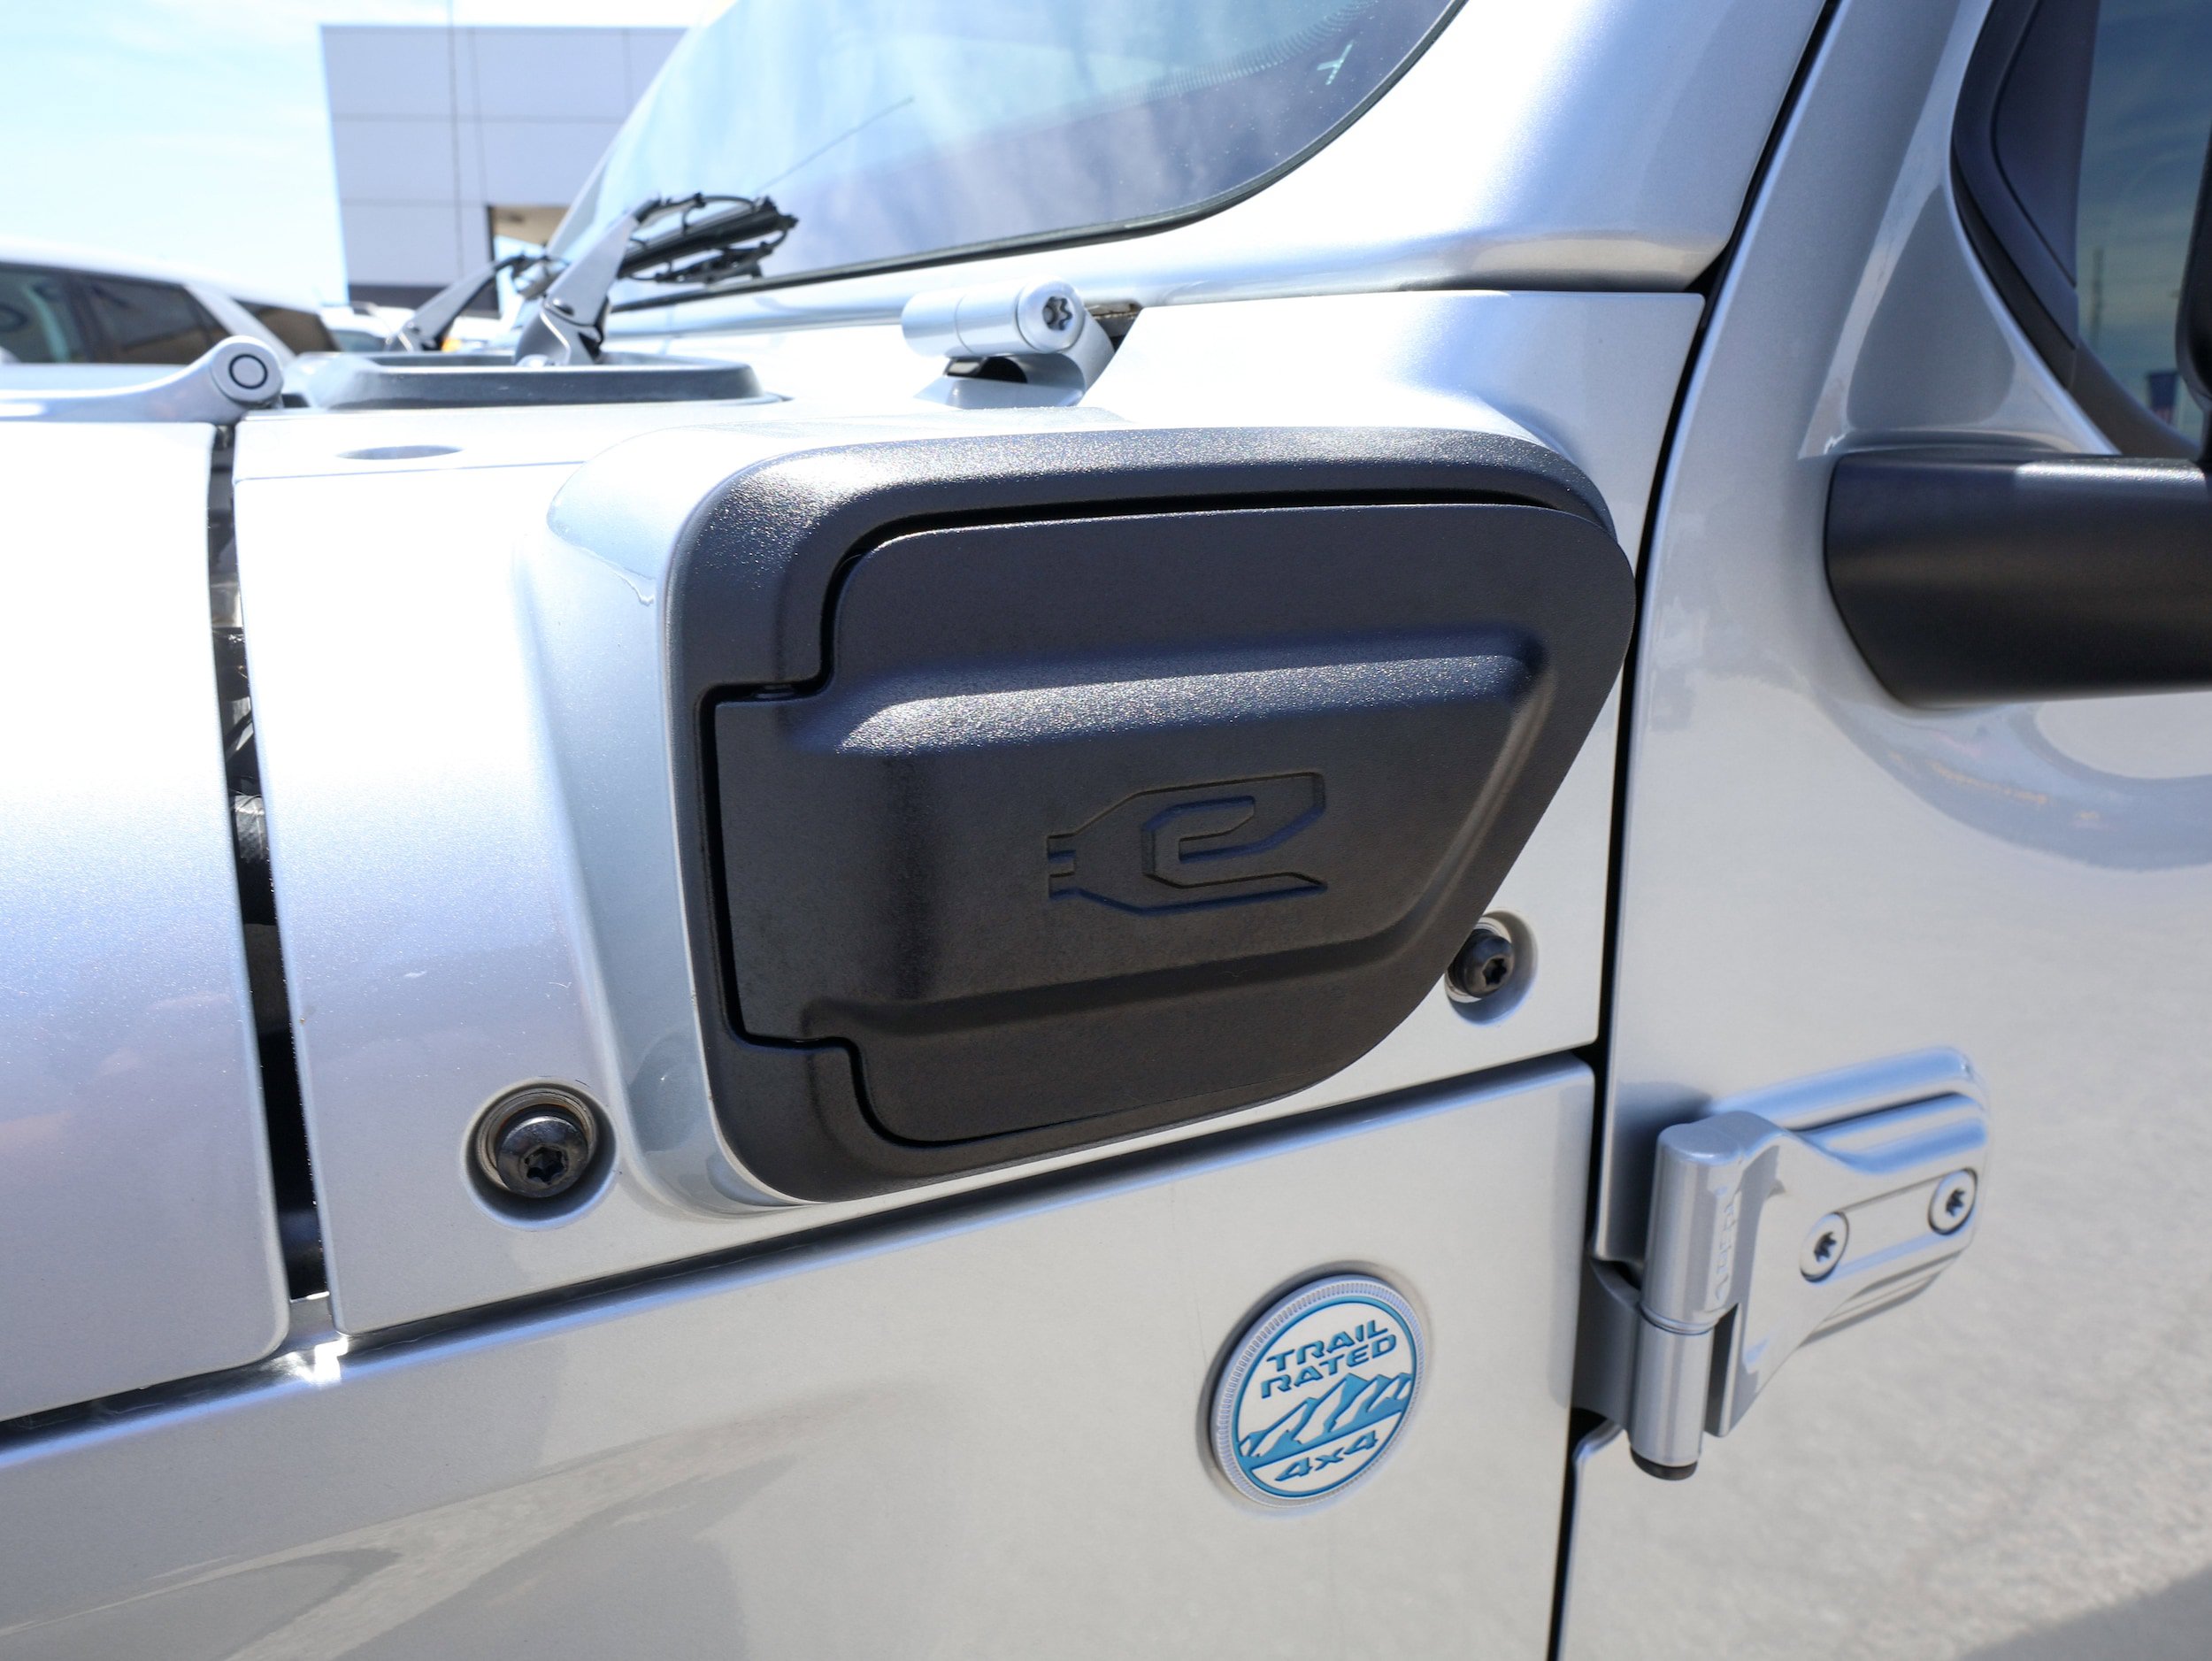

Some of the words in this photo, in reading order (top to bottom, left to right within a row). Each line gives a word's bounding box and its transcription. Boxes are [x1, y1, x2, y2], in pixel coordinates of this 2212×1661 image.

[1260, 1334, 1397, 1399] RATED
[1266, 1319, 1388, 1373] TRAIL
[1274, 1430, 1379, 1482] 4x4
